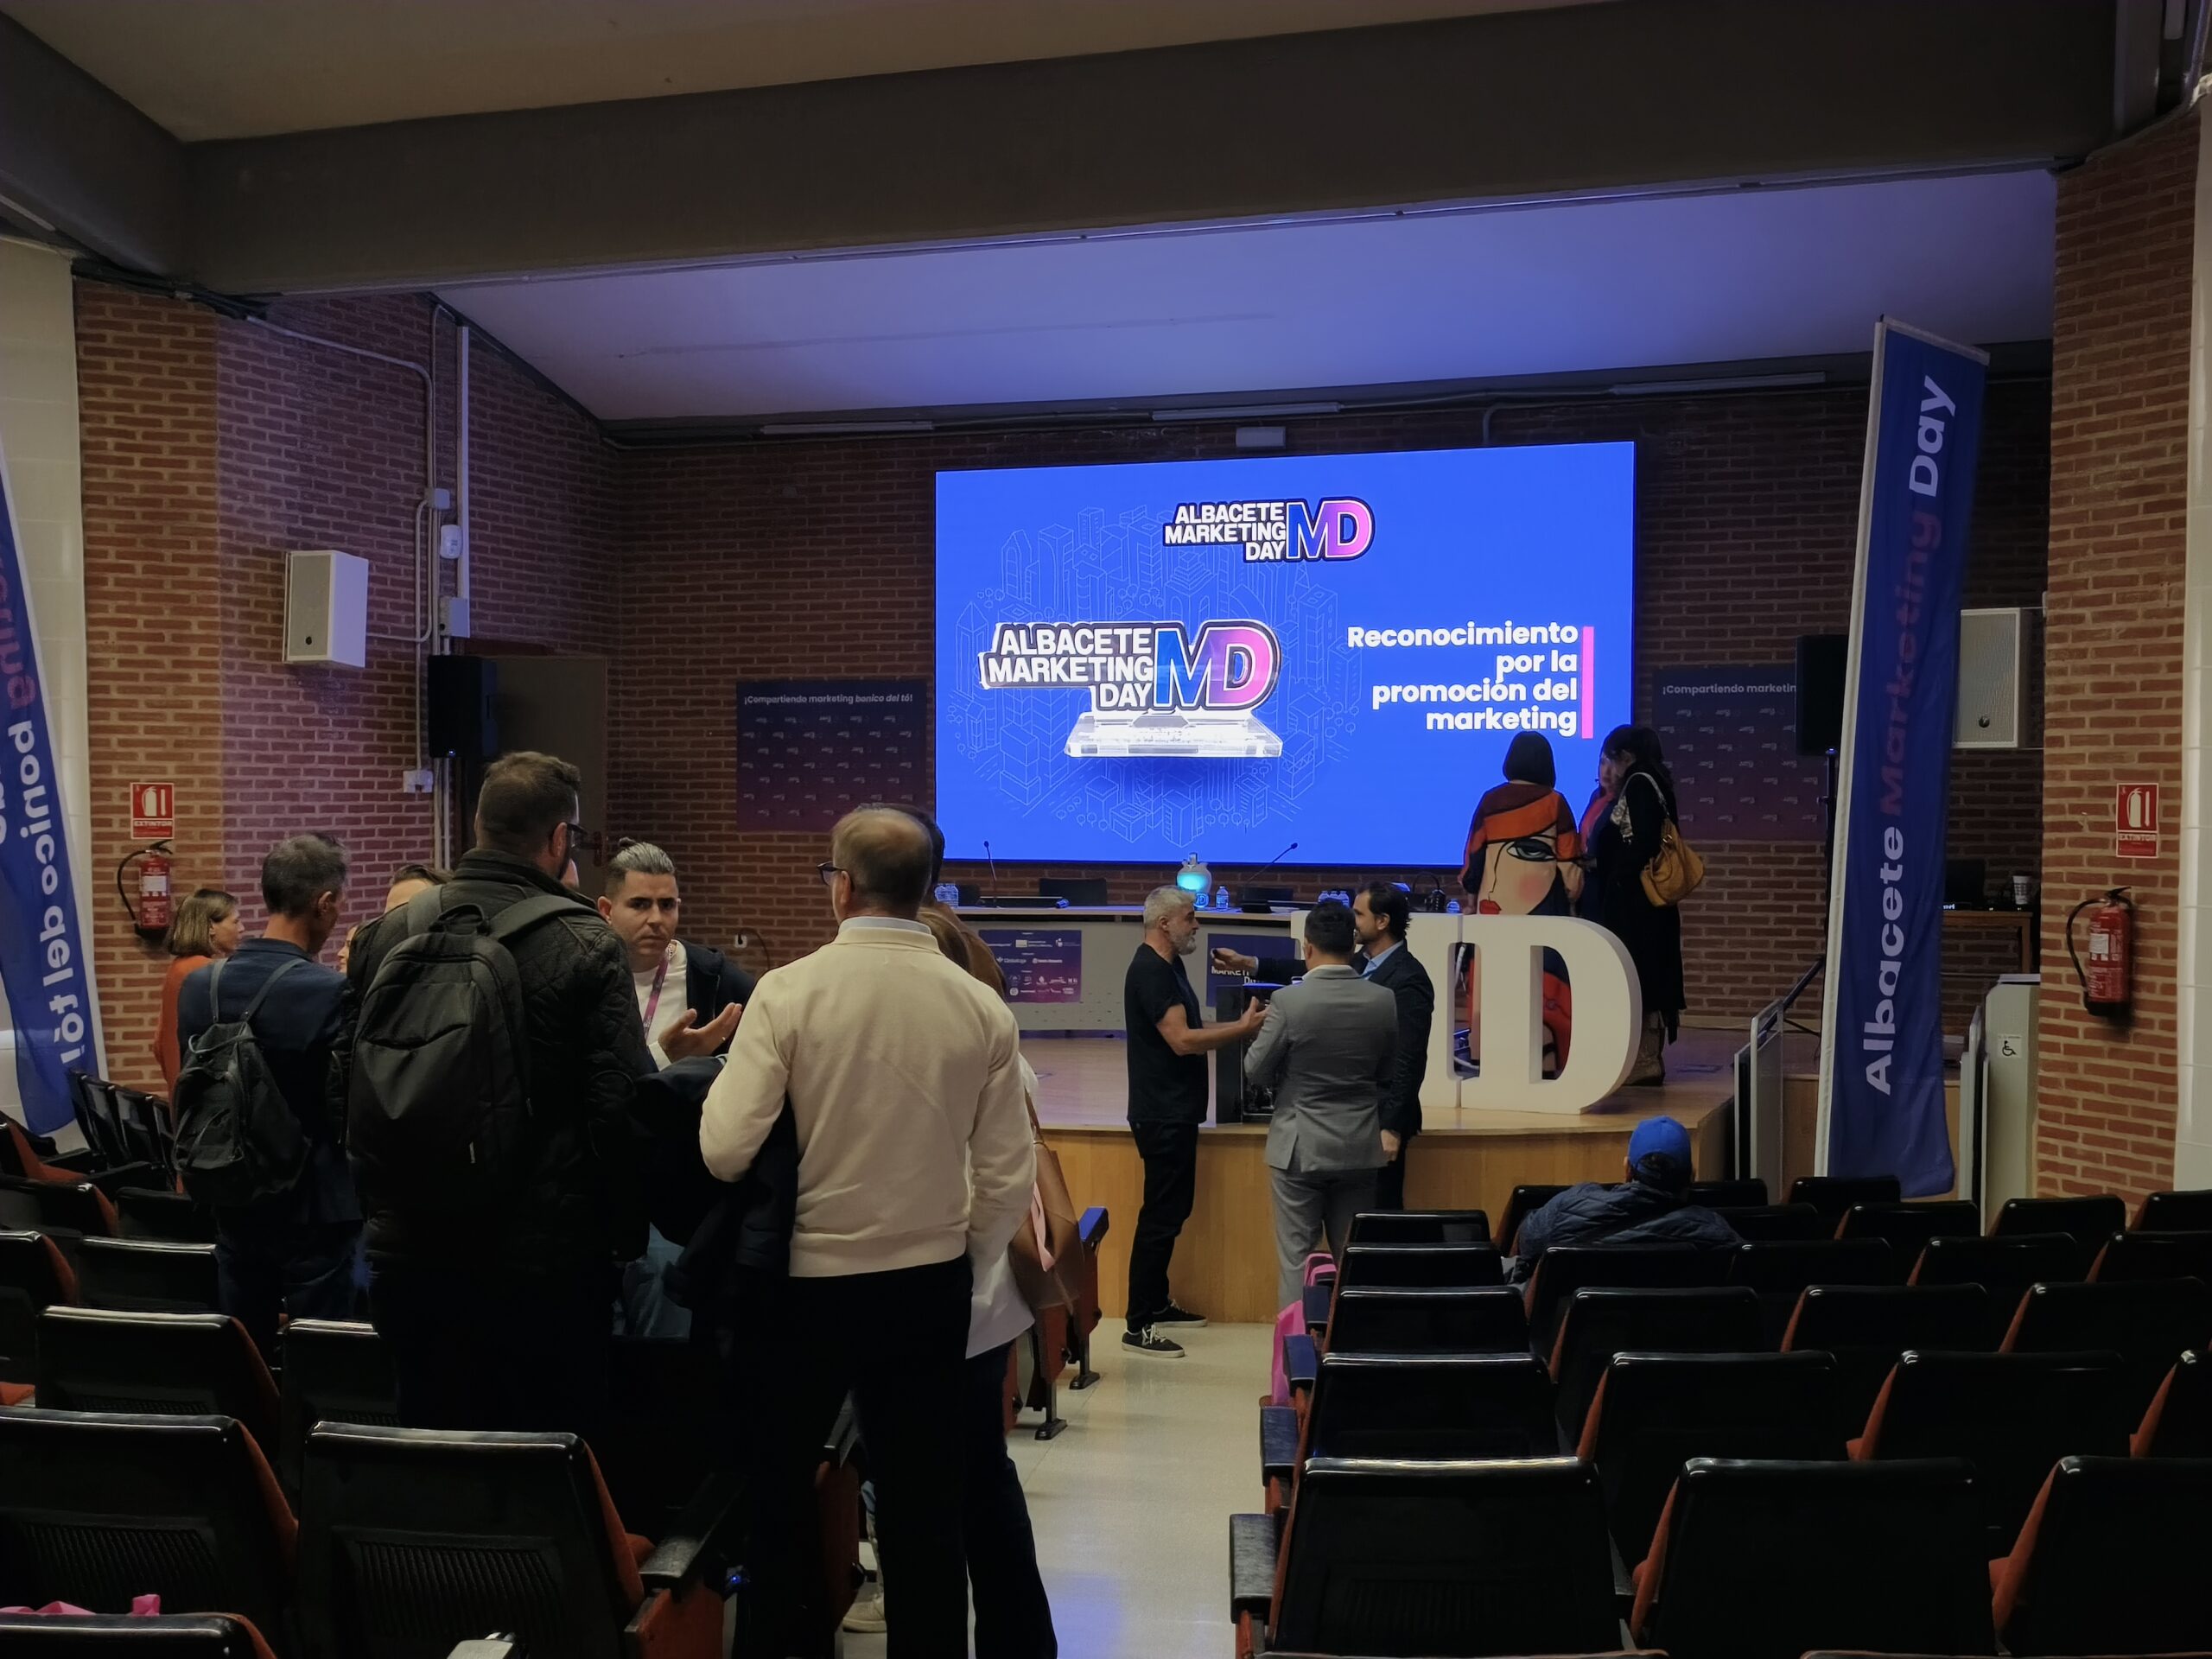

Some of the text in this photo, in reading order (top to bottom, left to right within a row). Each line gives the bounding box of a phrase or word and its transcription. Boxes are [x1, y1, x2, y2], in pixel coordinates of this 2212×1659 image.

[1174, 502, 1285, 524] ALBACETE
[1165, 522, 1286, 544] MARKETING
[1286, 499, 1372, 559] MD
[1245, 541, 1286, 561] DAY
[1001, 628, 1152, 655] ALBACETE
[1347, 620, 1579, 648] Reconocimiento
[988, 656, 1154, 683] MARKETING
[1154, 626, 1273, 707] MD
[1496, 650, 1578, 683] por la
[809, 694, 854, 705] marketing
[886, 693, 900, 702] del
[1100, 683, 1153, 708] DAY
[1372, 677, 1578, 710] promoción del
[1746, 683, 1797, 694] marketin
[1426, 705, 1578, 737] marketing
[1863, 375, 1957, 1096] Albacete Marketing Day
